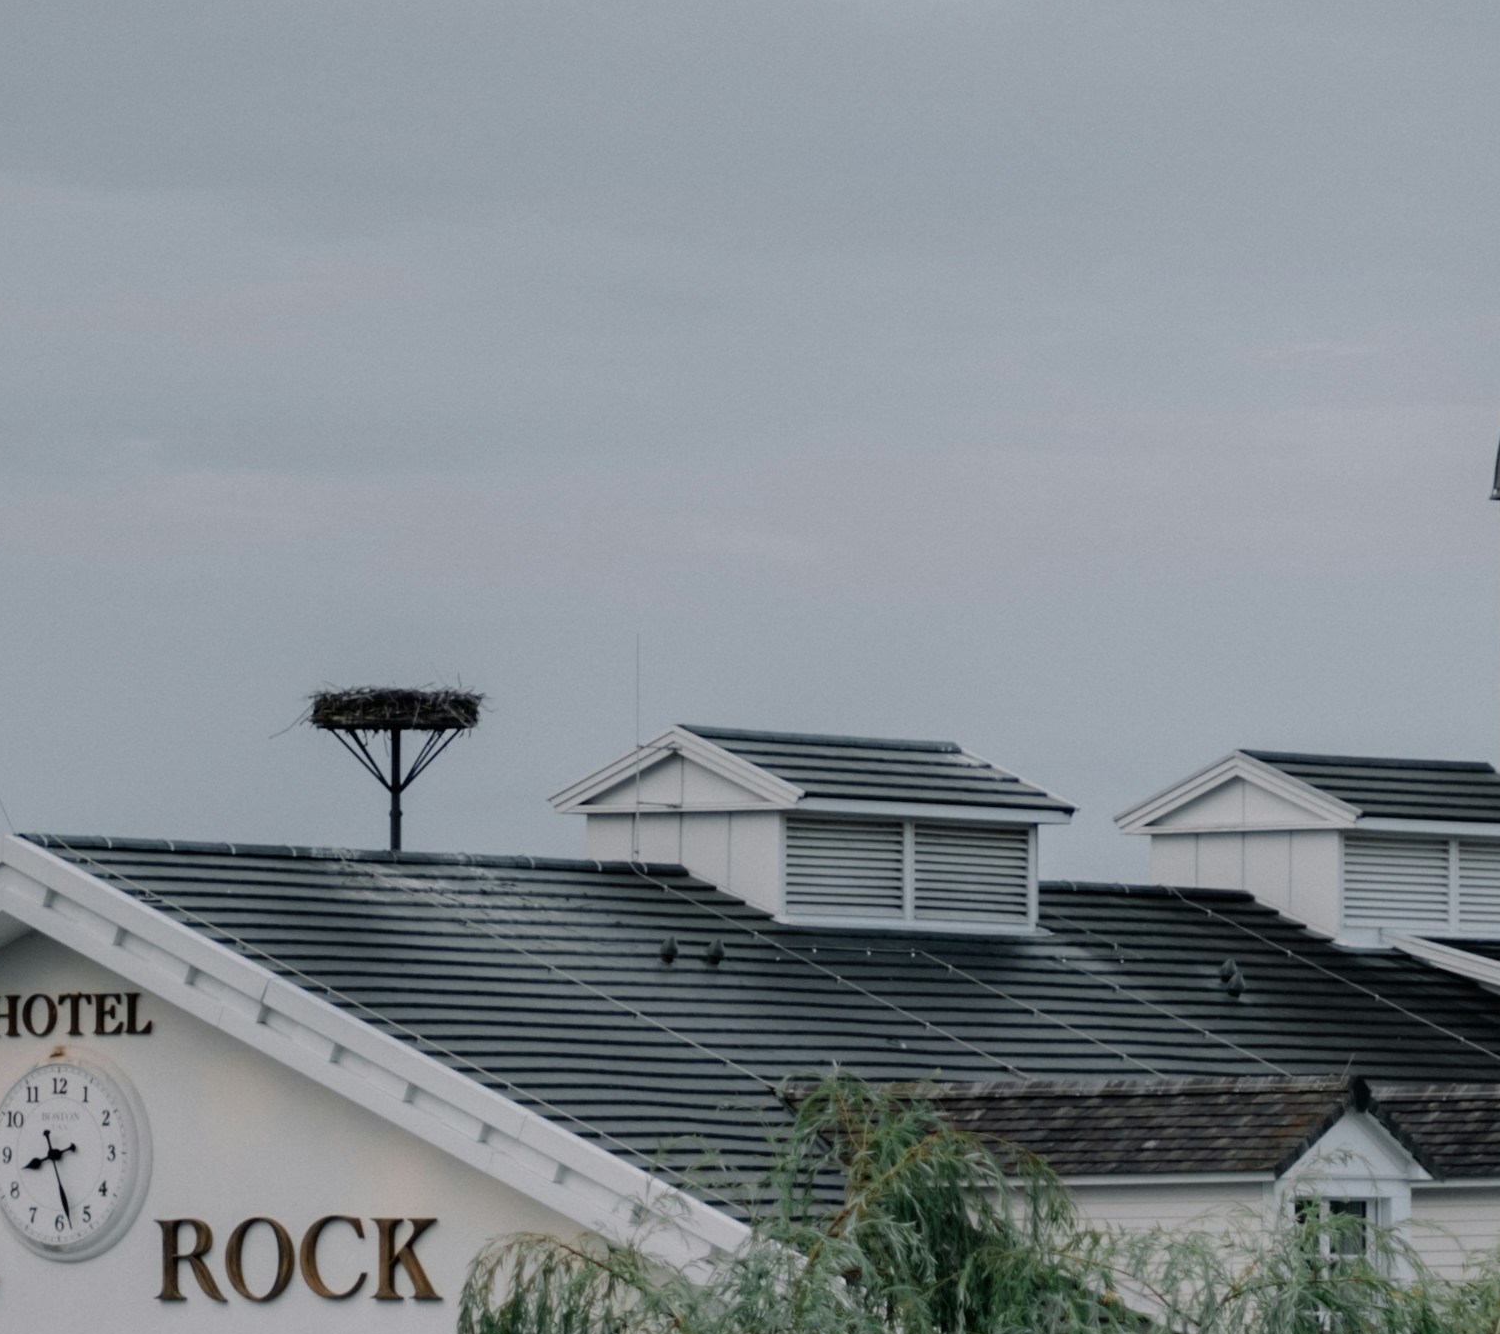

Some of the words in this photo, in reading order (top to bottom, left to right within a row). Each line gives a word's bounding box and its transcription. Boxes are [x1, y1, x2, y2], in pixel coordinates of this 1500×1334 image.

[26, 1086, 39, 1103] 11
[52, 1077, 68, 1095] 12
[82, 1085, 89, 1103] 1
[7, 1110, 25, 1128] 10
[101, 1110, 111, 1127] 2
[2, 1147, 13, 1164] 9
[107, 1144, 116, 1161] 3
[10, 1182, 20, 1199] 8
[98, 1180, 108, 1197] 4
[29, 1206, 38, 1224] 7
[54, 1214, 65, 1232] 6
[82, 1205, 92, 1224] 5
[156, 1216, 443, 1304] ROCK
